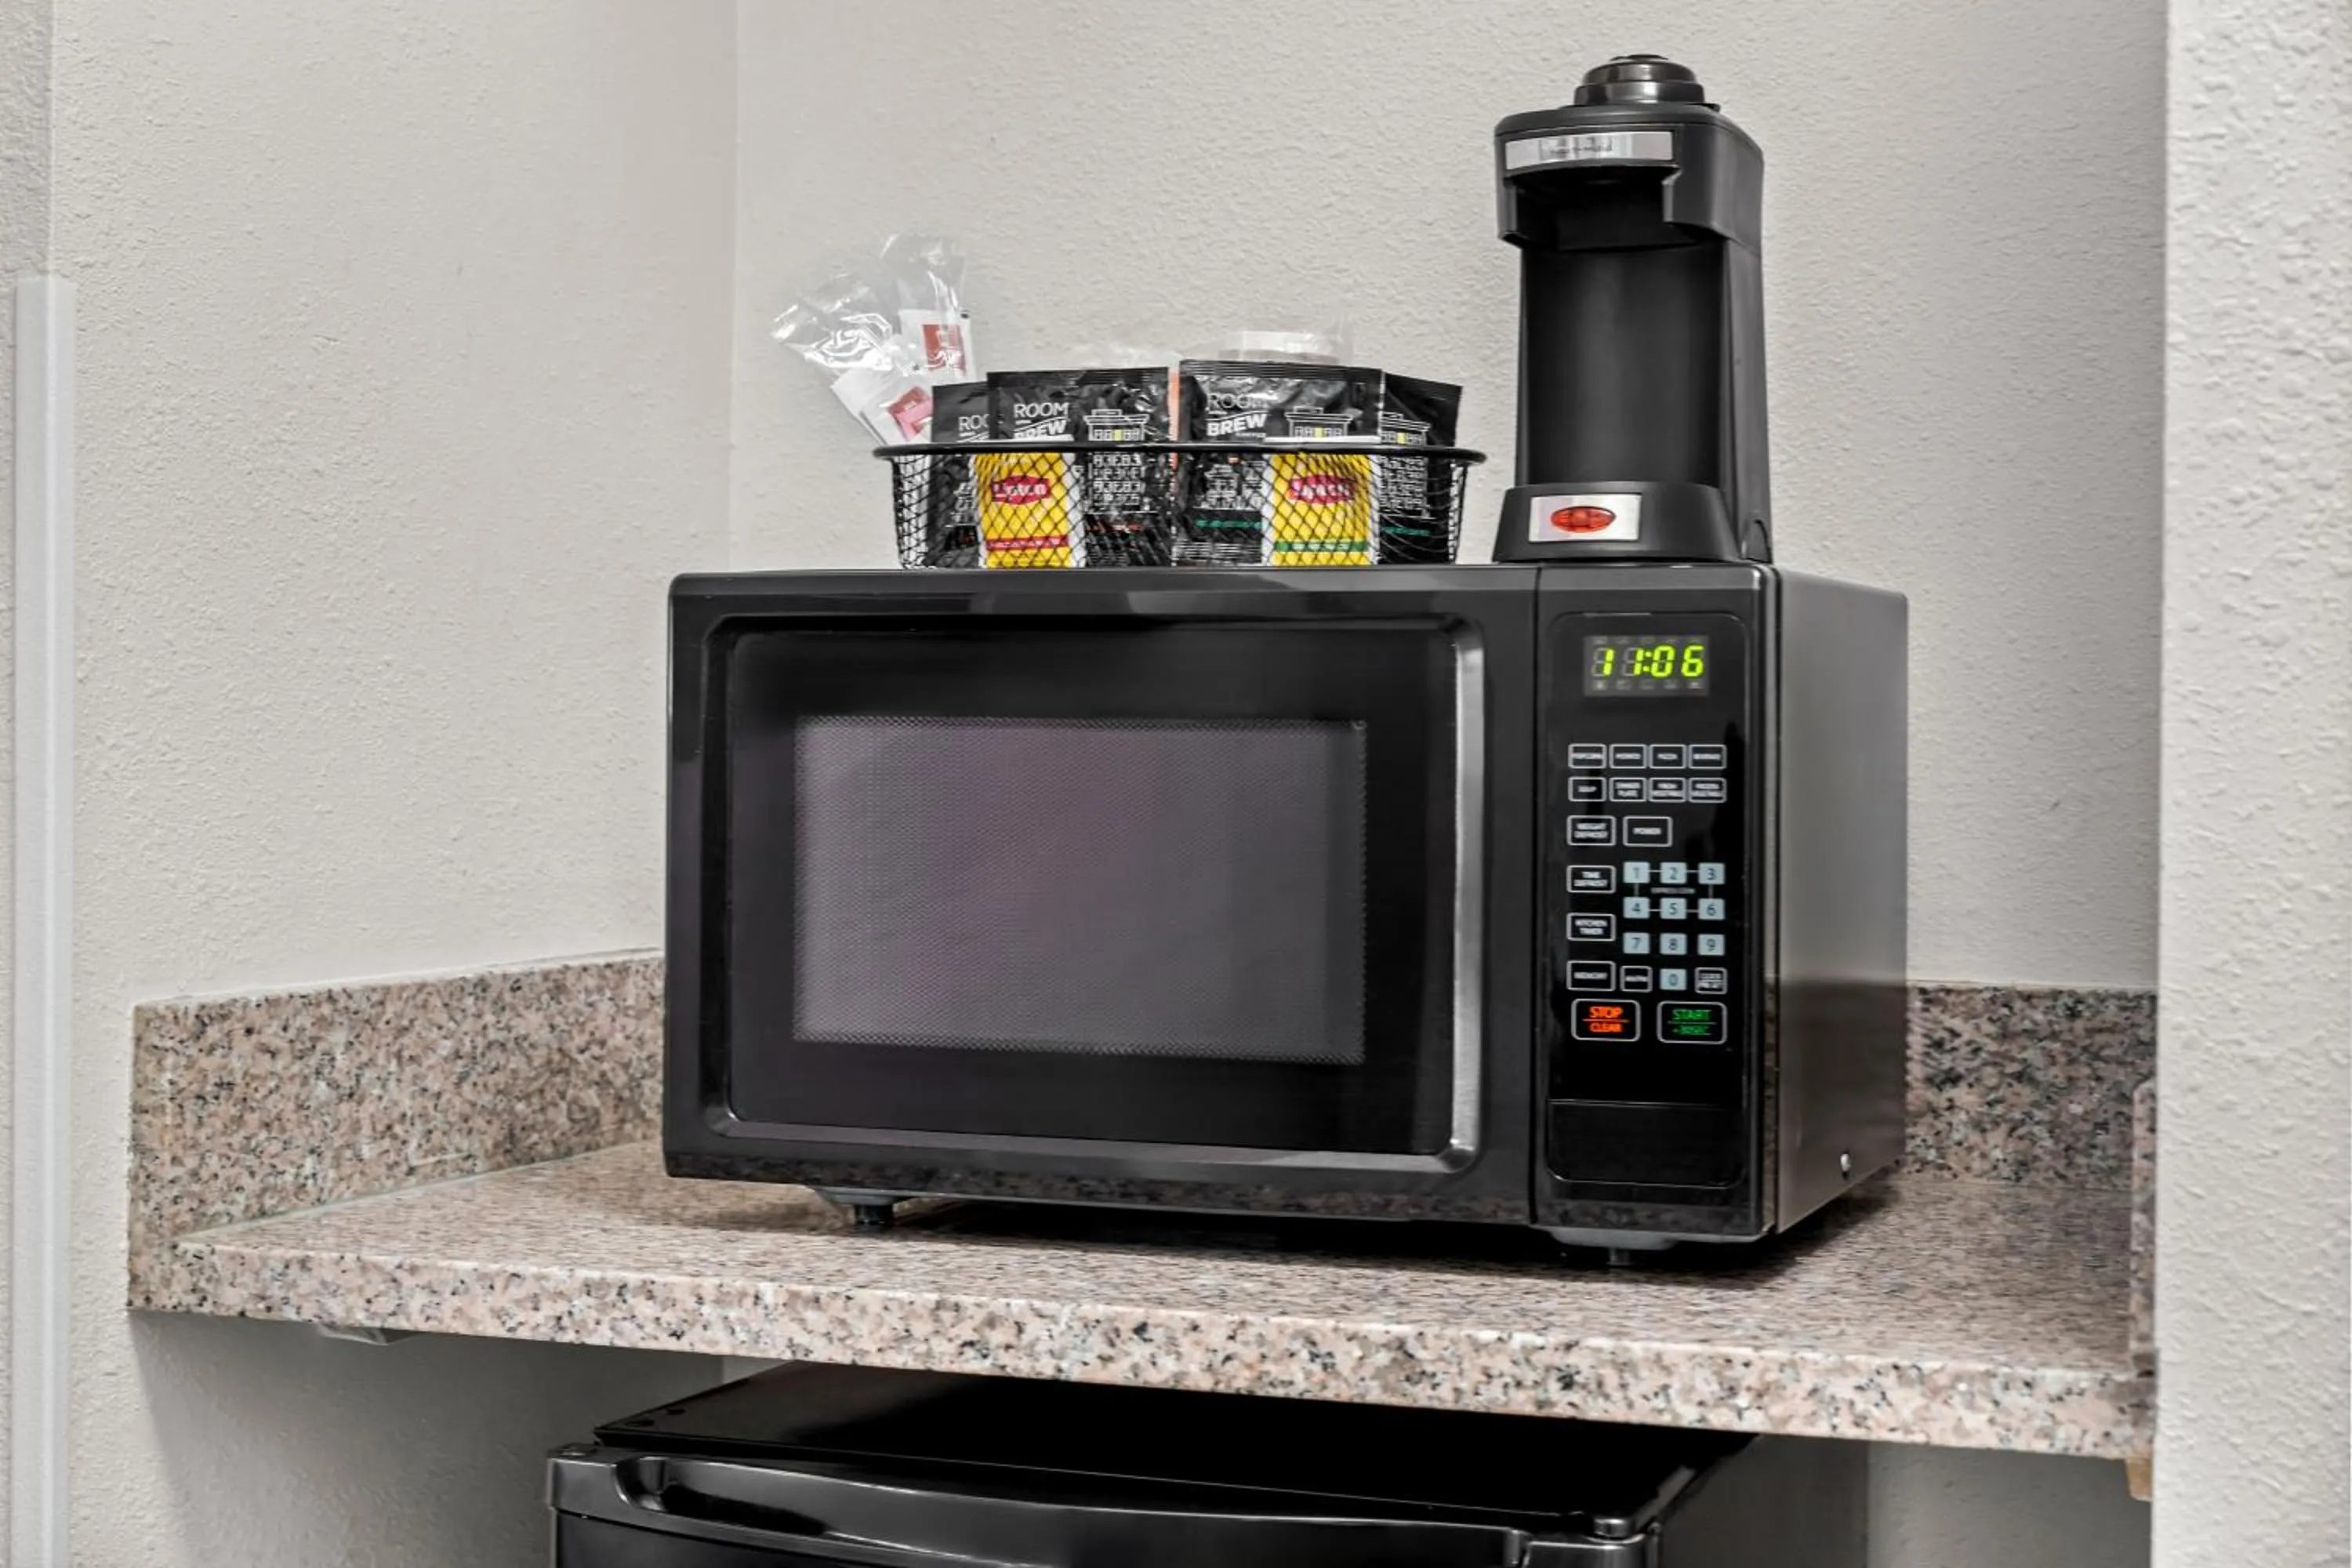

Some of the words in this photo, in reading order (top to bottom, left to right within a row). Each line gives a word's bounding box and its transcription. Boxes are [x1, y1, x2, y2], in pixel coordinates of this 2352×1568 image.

[1013, 402, 1069, 418] ROOM
[1207, 414, 1267, 436] BREW
[1602, 644, 1704, 677] 11:06
[1669, 867, 1678, 880] 2
[1706, 868, 1716, 880] 3
[1669, 903, 1678, 916] 5
[1706, 903, 1716, 916] 6
[1632, 937, 1641, 949] 7
[1668, 938, 1679, 950] 8
[1706, 938, 1716, 951] 9
[1668, 973, 1679, 986] 0
[1589, 1006, 1623, 1018] STOP
